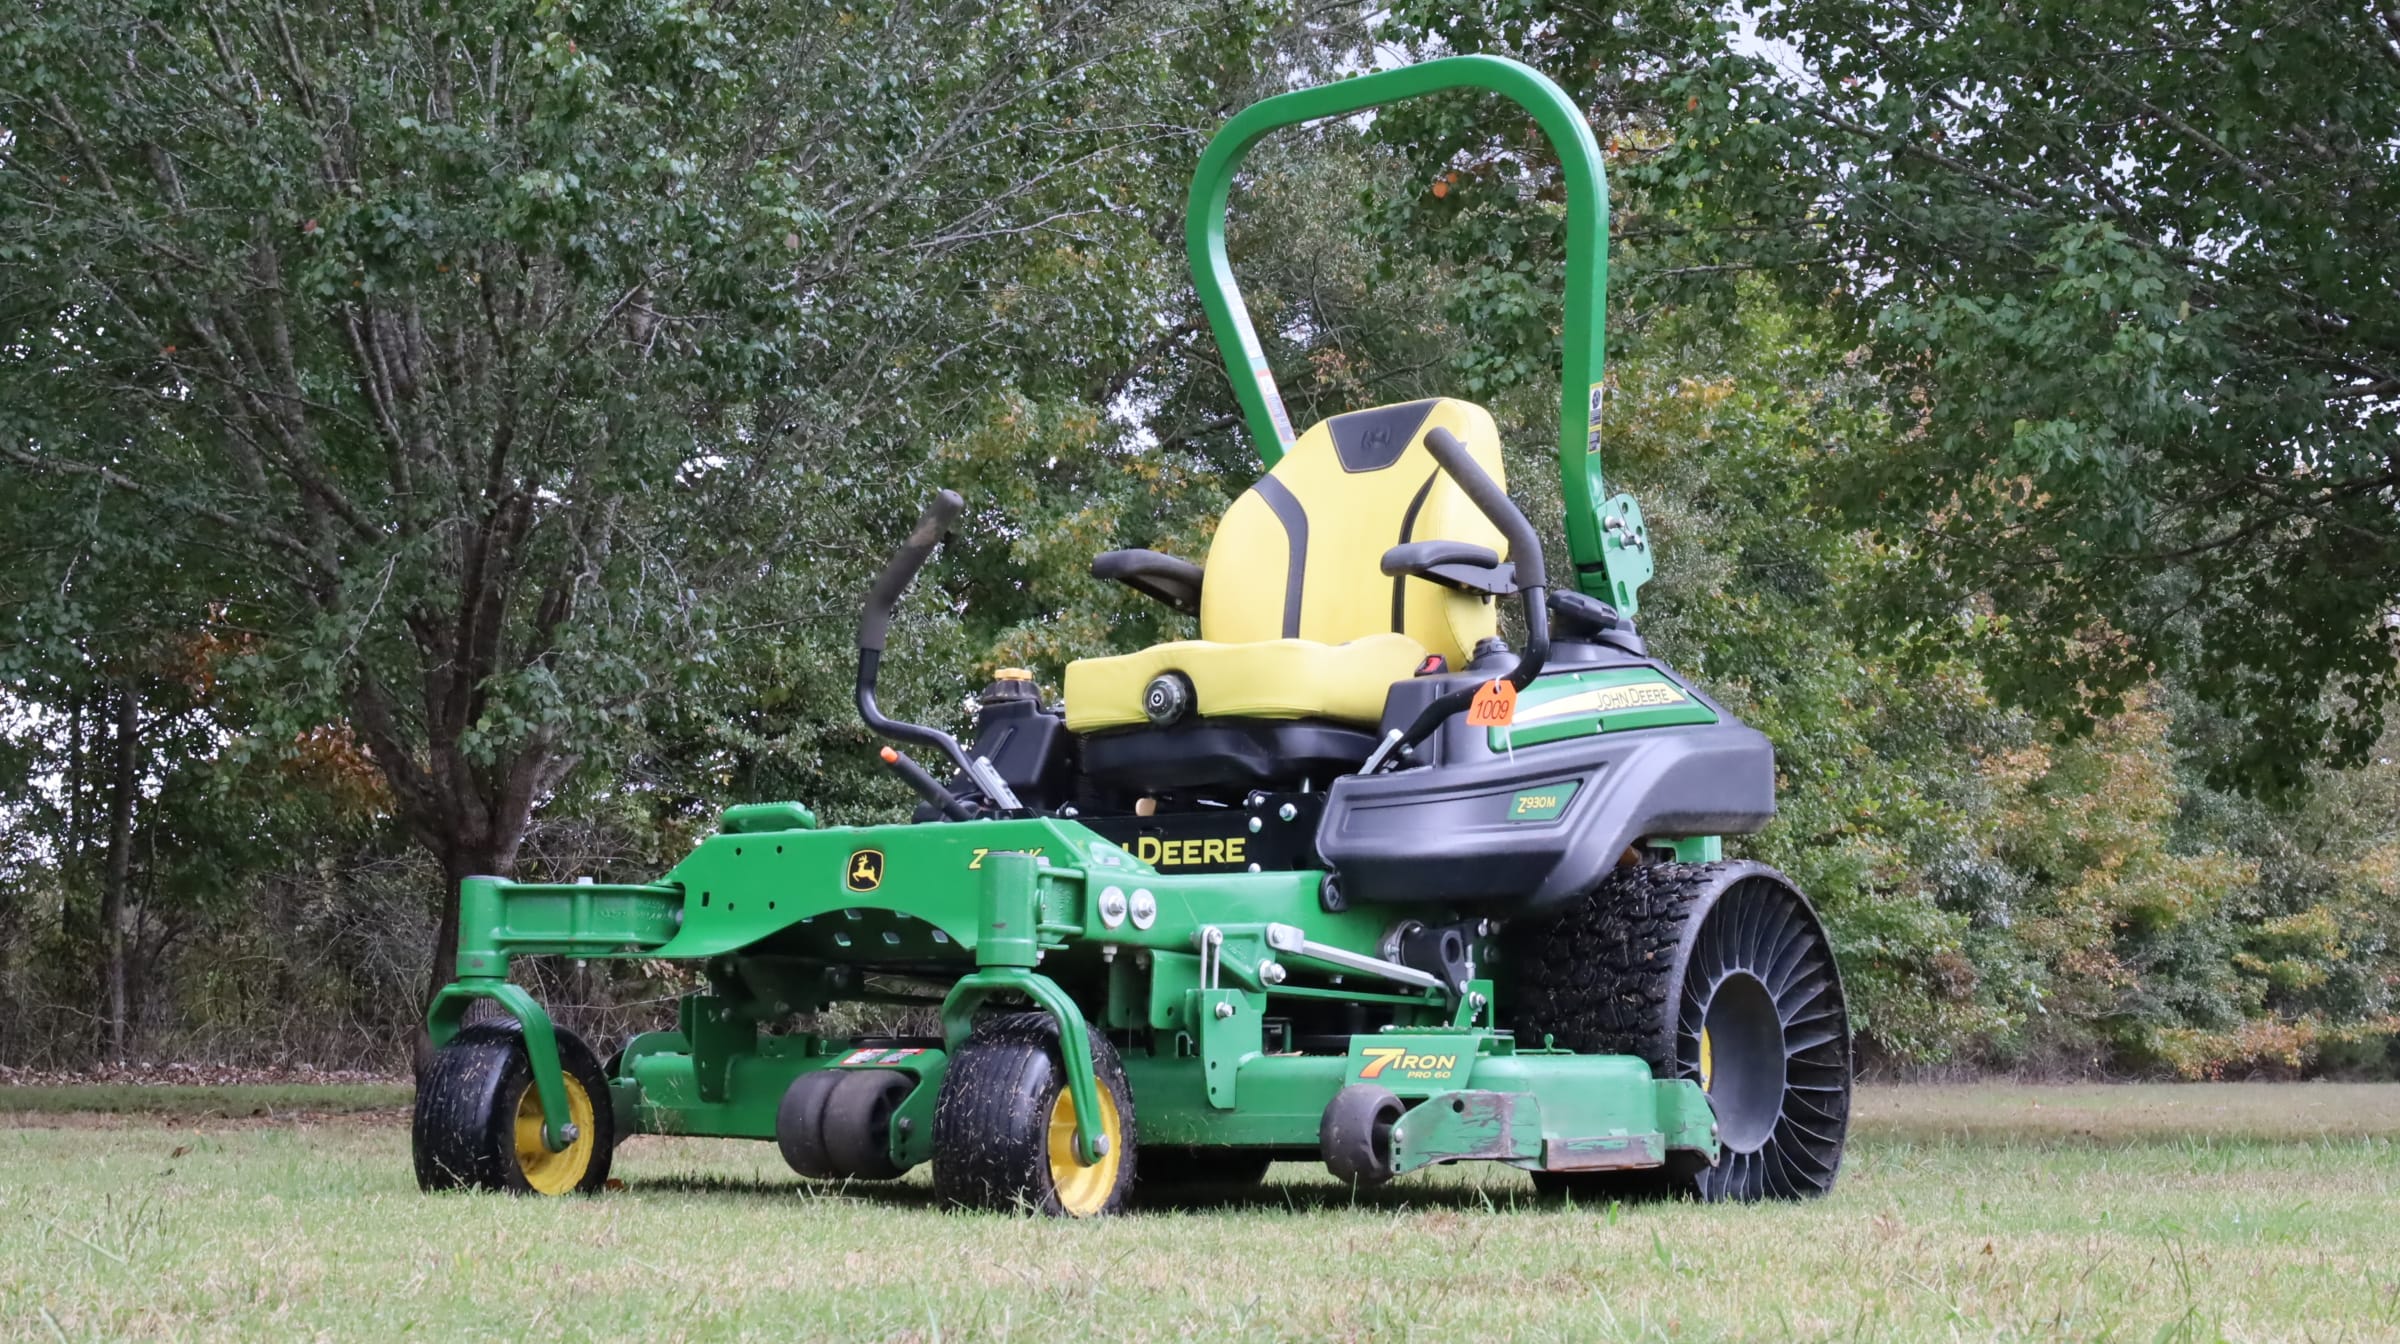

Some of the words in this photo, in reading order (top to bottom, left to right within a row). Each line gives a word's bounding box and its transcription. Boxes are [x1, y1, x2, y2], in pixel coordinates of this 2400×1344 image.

[1597, 690, 1628, 709] JOHN
[1628, 687, 1670, 705] DEERE
[1477, 699, 1510, 720] 1009
[1517, 796, 1556, 813] Z930M
[1138, 836, 1246, 866] DEERE
[1407, 1071, 1431, 1079] PRO
[1433, 1071, 1451, 1079] 60
